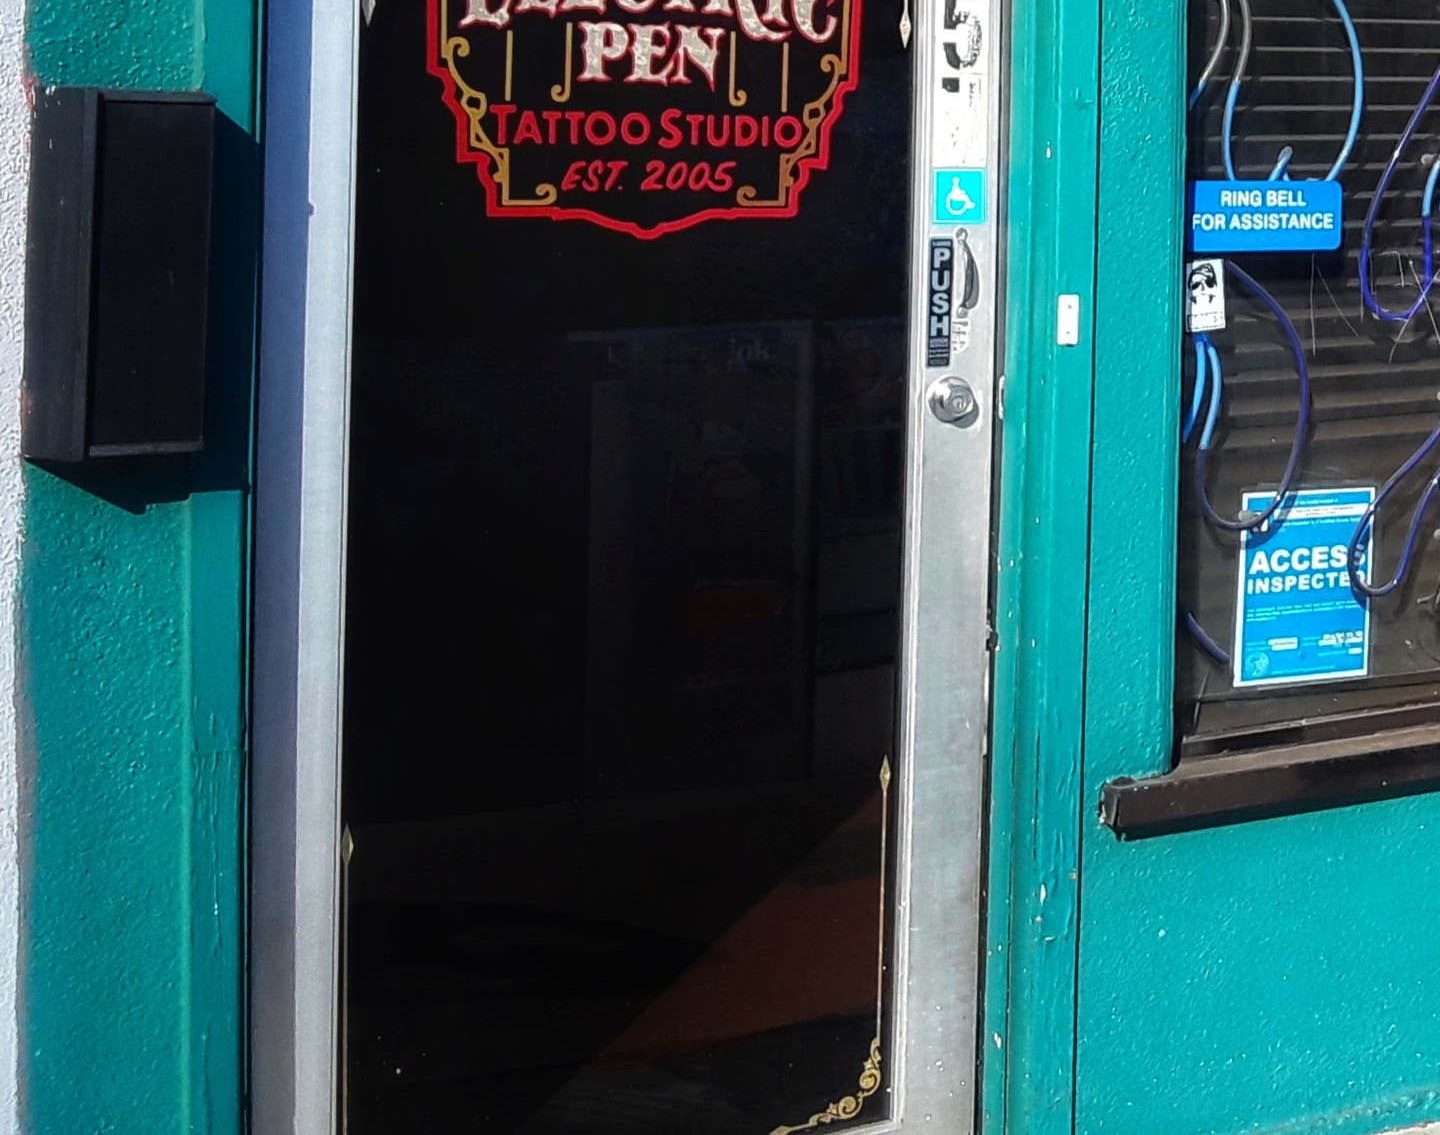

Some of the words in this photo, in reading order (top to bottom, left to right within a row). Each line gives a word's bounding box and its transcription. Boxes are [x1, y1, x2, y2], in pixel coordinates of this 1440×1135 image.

[579, 22, 726, 91] PEN
[489, 103, 650, 147] TATTOO
[658, 108, 803, 149] STUDIO
[561, 161, 625, 192] EST.
[640, 160, 737, 192] 2005
[1220, 190, 1263, 208] RING
[1265, 189, 1307, 207] BELL
[1192, 213, 1226, 230] FOR
[1229, 212, 1334, 230] ASSISTANCE
[930, 247, 952, 337] PUSH
